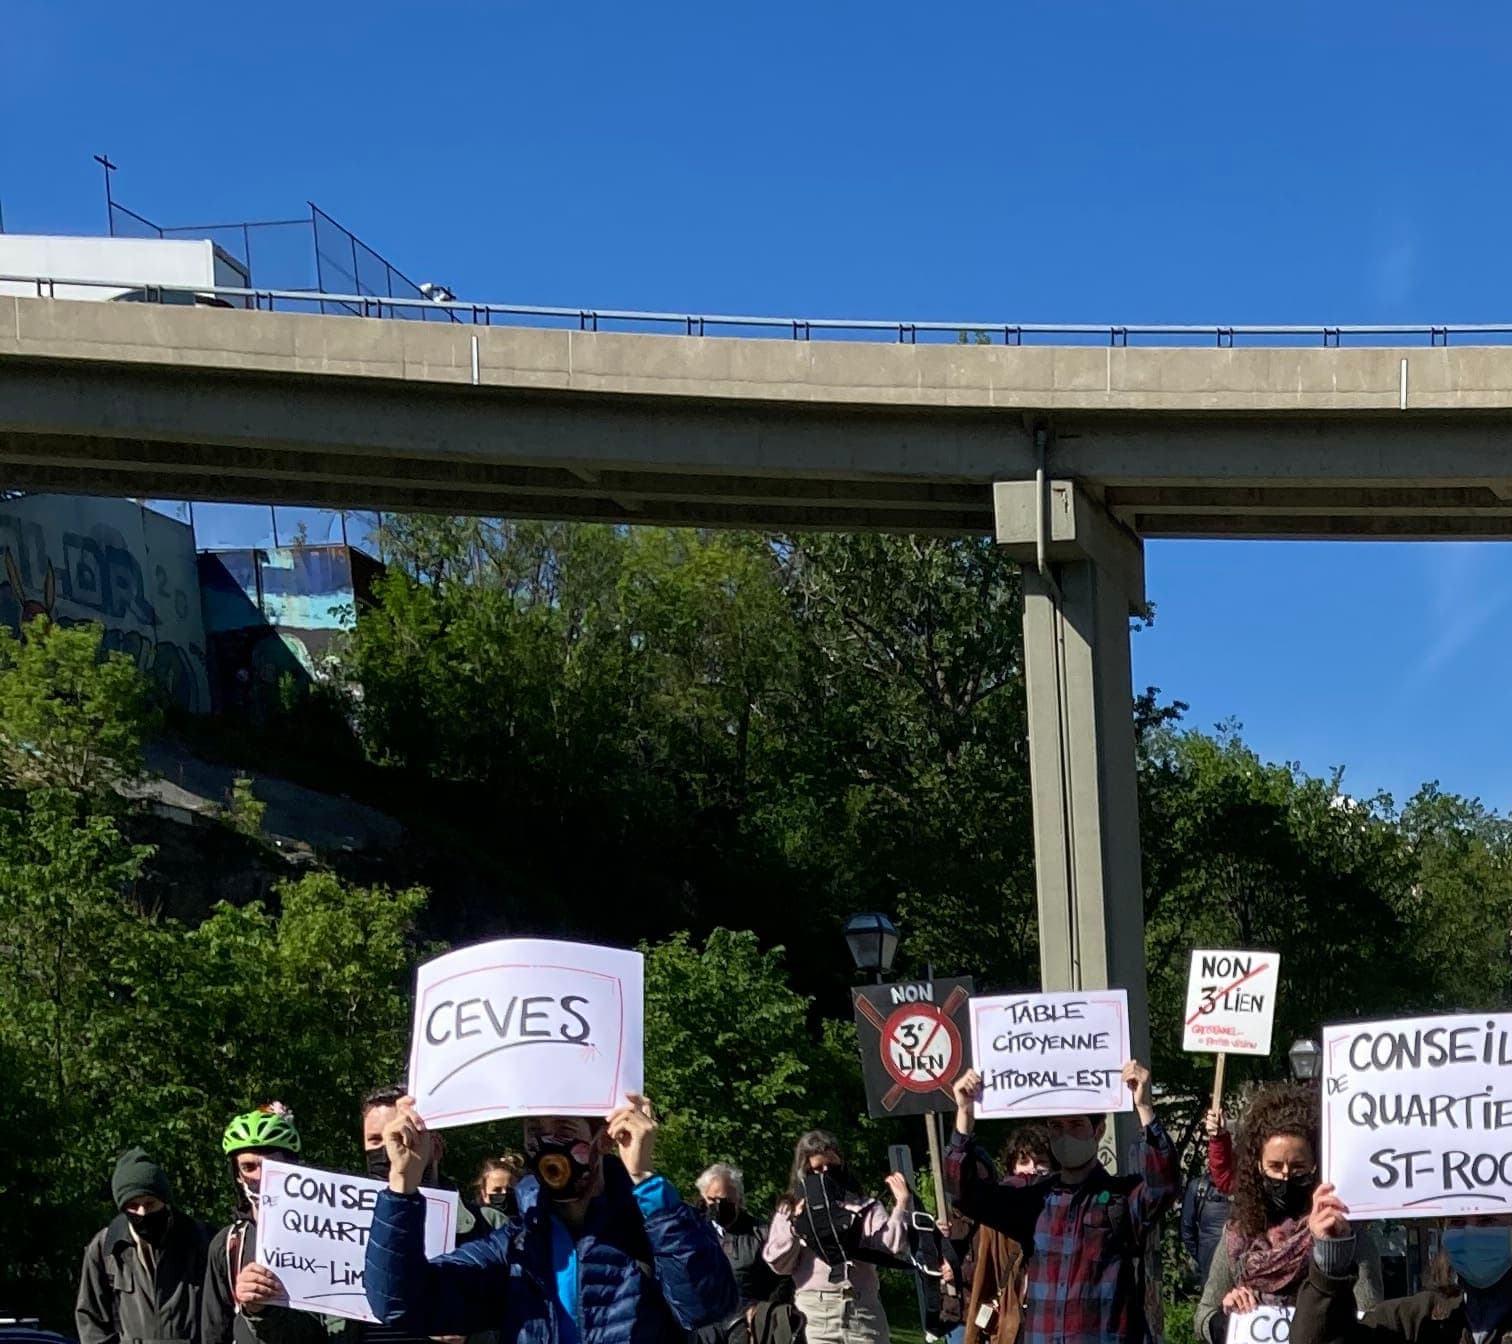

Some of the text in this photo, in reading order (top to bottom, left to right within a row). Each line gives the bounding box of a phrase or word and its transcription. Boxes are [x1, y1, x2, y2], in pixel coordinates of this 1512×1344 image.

[1201, 956, 1252, 979] NON
[891, 983, 934, 1004] NON
[426, 996, 591, 1047] CEVES
[1004, 1000, 1088, 1025] TABLE
[898, 1053, 943, 1071] LIEN
[1327, 1074, 1349, 1095] DE
[262, 1195, 280, 1207] DE
[284, 1173, 378, 1211] CONSE
[283, 1209, 371, 1246] QUART
[263, 1246, 366, 1289] VIEUX-LIM
